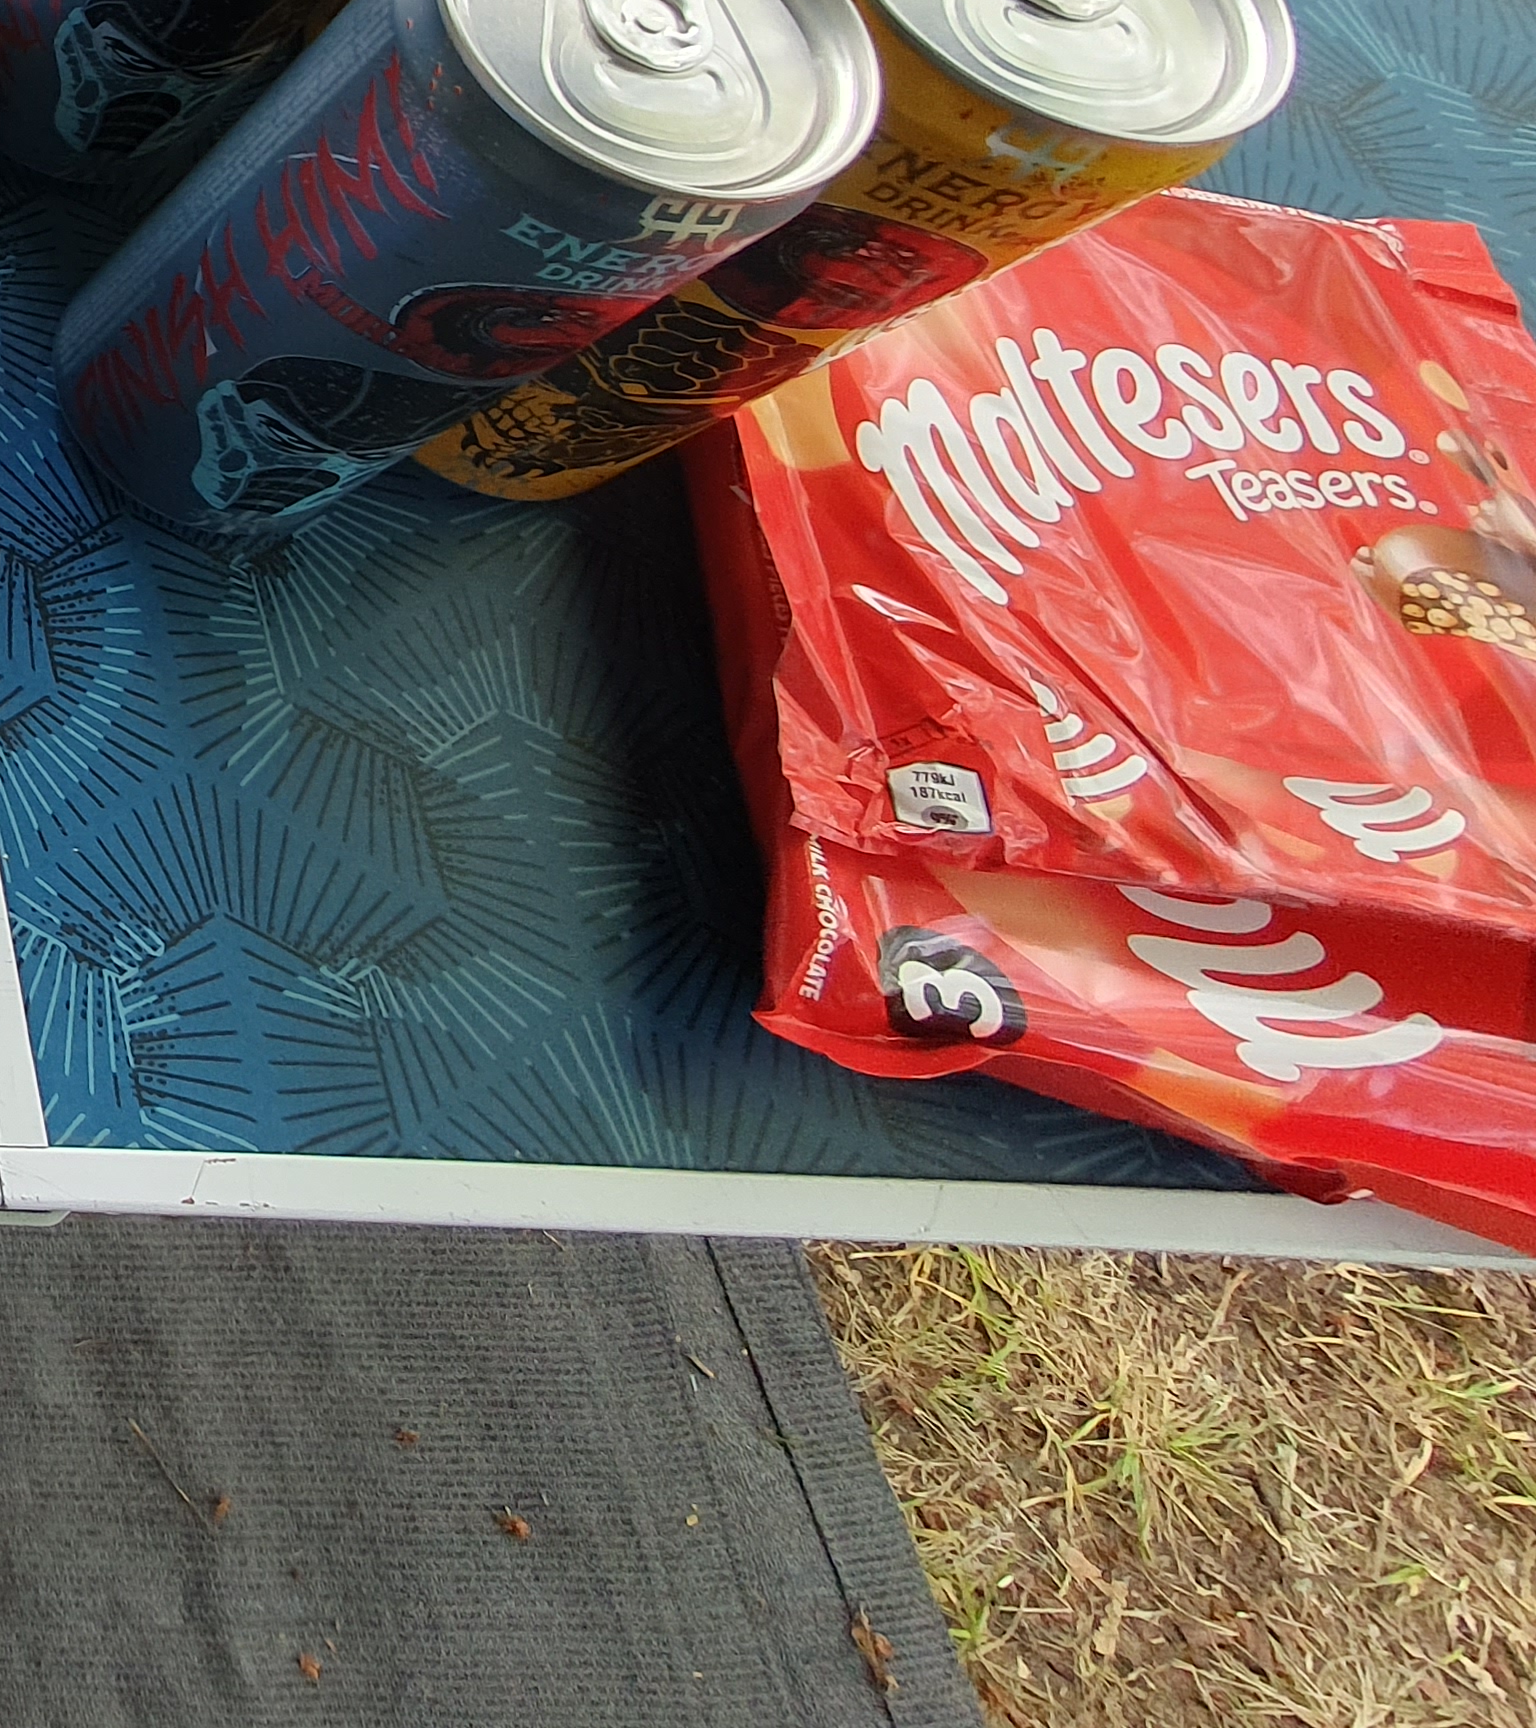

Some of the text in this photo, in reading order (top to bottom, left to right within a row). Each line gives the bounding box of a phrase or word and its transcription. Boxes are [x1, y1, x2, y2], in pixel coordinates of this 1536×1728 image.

[255, 47, 451, 305] HIM!
[855, 327, 1407, 607] Maltesers
[1185, 459, 1415, 522] Teasers
[909, 785, 968, 804] 187kcal
[911, 770, 956, 787] 779kJ
[798, 883, 840, 1003] CHOCOLATE
